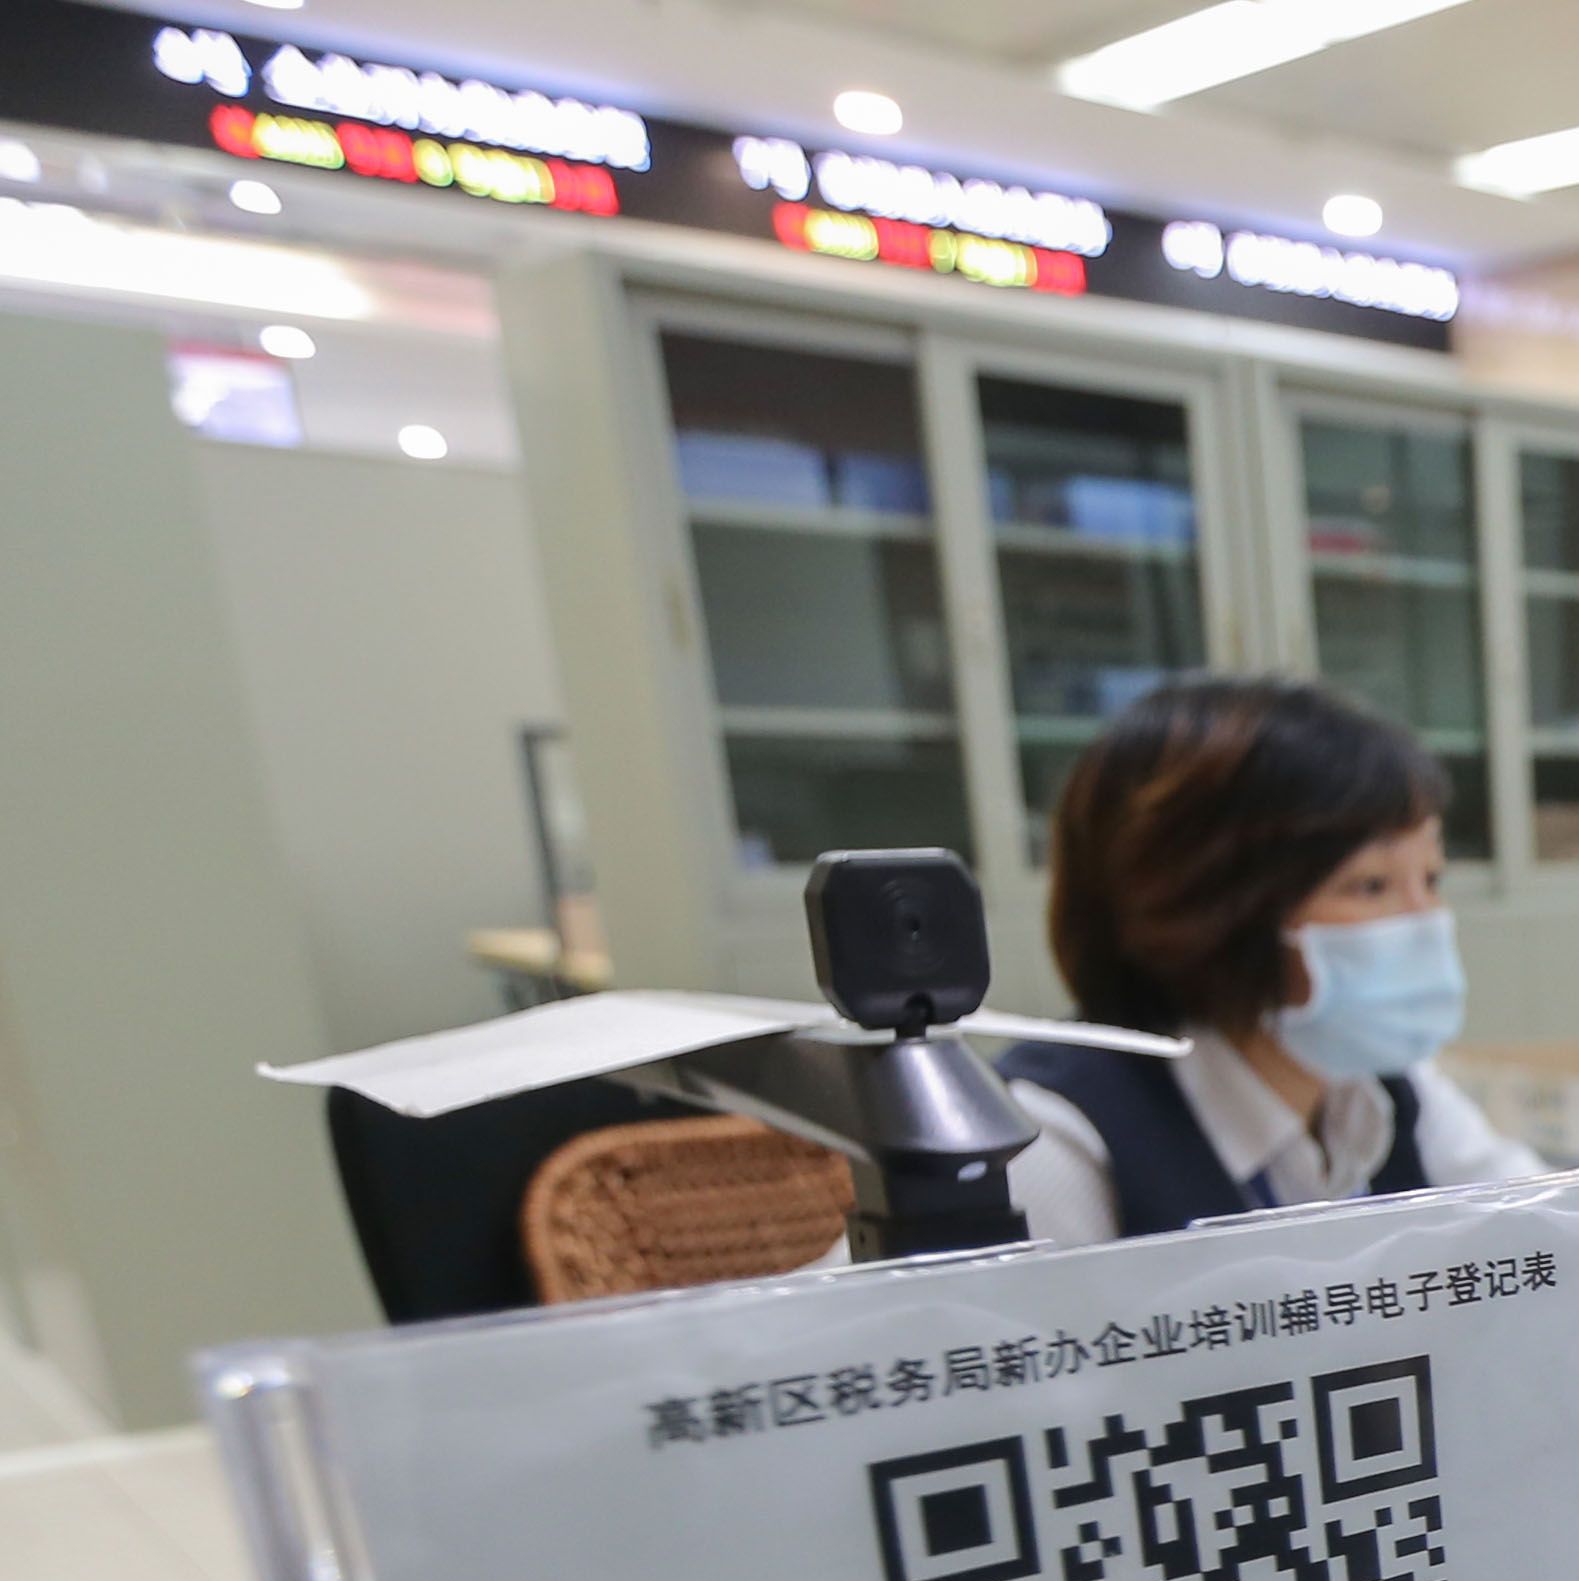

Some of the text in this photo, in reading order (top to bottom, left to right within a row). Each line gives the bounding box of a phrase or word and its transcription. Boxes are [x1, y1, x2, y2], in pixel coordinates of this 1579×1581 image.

[645, 1250, 1559, 1450] 高新区税务局新办企业培训辅导电子登记表
